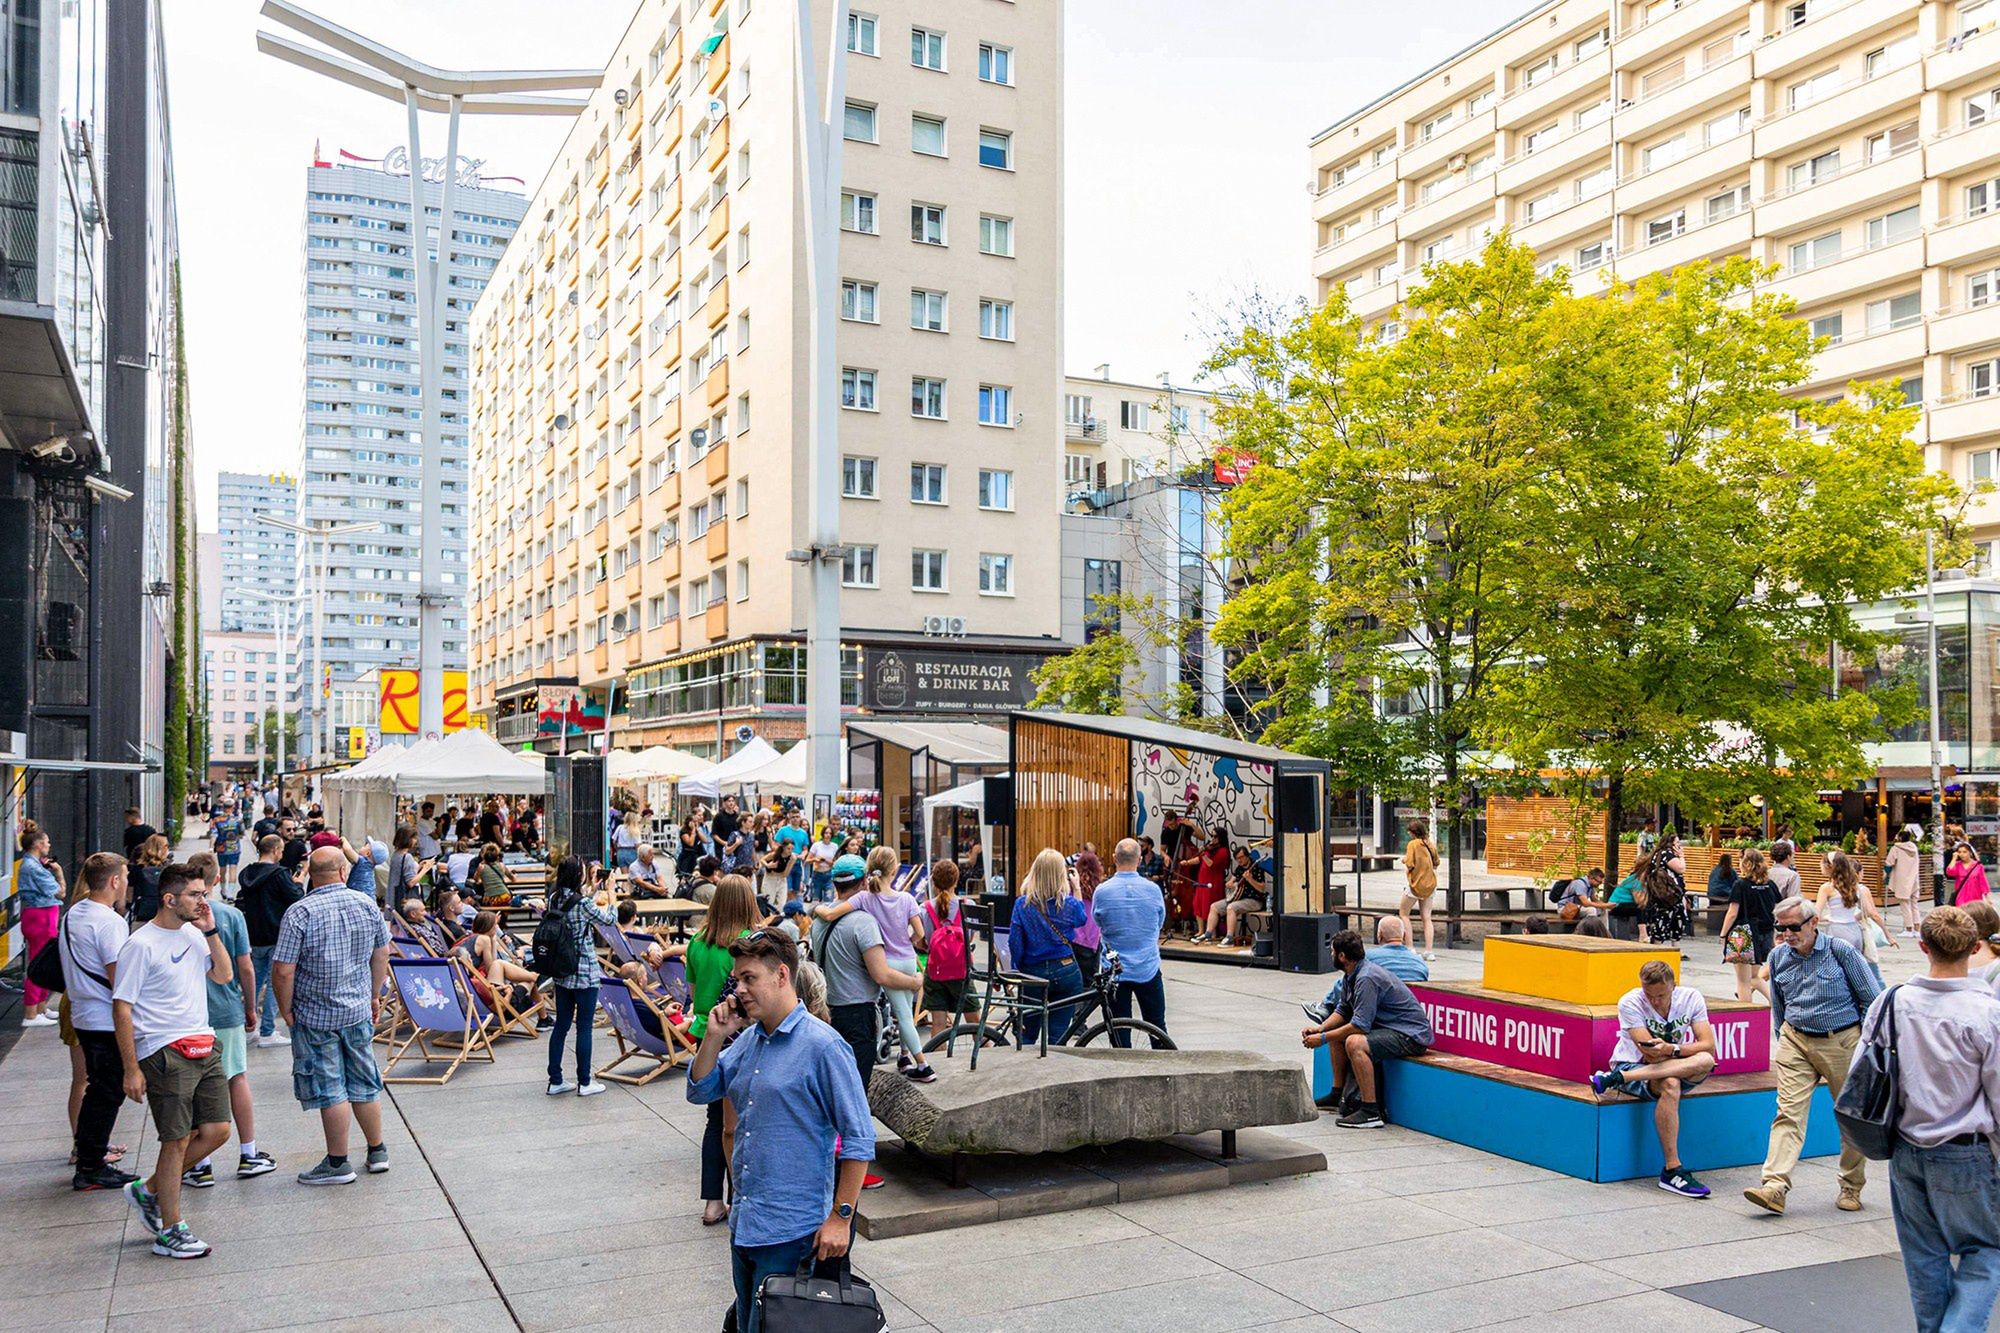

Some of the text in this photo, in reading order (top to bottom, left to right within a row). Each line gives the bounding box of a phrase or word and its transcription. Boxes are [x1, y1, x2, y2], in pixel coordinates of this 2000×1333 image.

[915, 662, 1012, 678] RESTAURACJA
[918, 678, 1010, 692] & DRINK BAR
[1420, 1002, 1565, 1060] MEETING POINT
